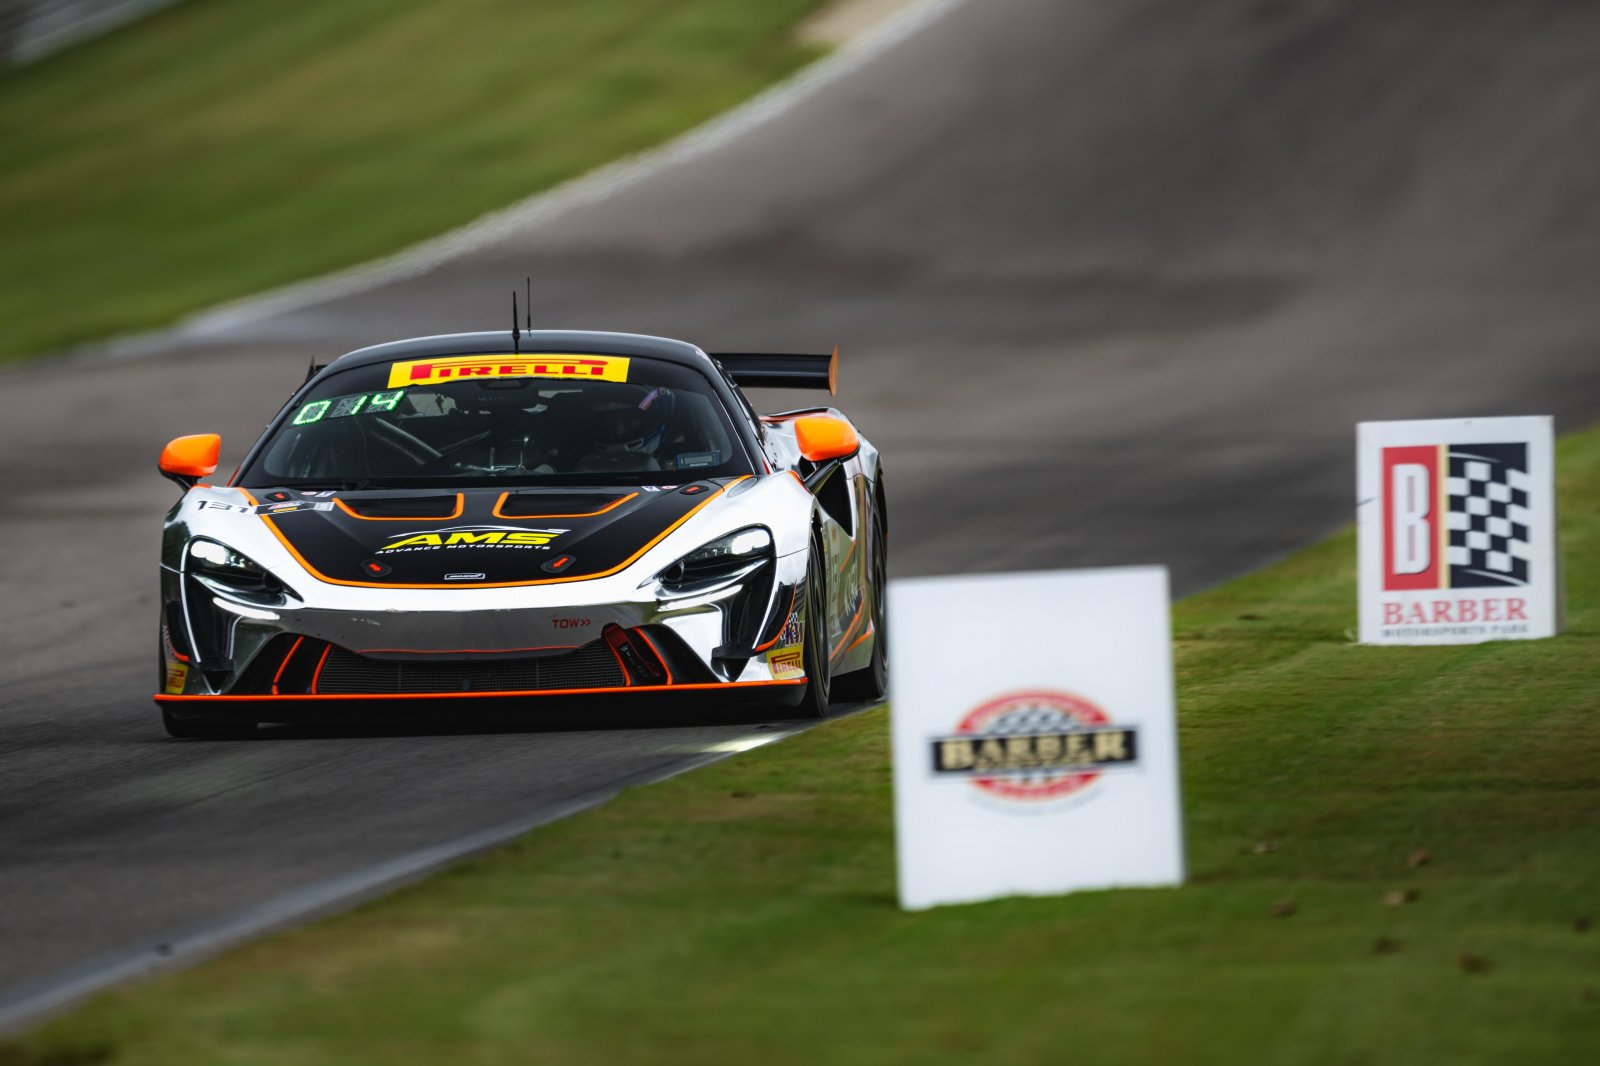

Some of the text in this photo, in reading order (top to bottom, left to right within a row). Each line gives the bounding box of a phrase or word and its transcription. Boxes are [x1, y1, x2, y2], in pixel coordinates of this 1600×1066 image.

[409, 358, 609, 380] PIRELLI
[1392, 463, 1431, 575] B
[374, 545, 440, 555] ADVANCE
[381, 532, 560, 550] AMS
[1382, 598, 1528, 625] BARBER
[552, 618, 579, 629] TOW
[940, 730, 1125, 770] BARBER
